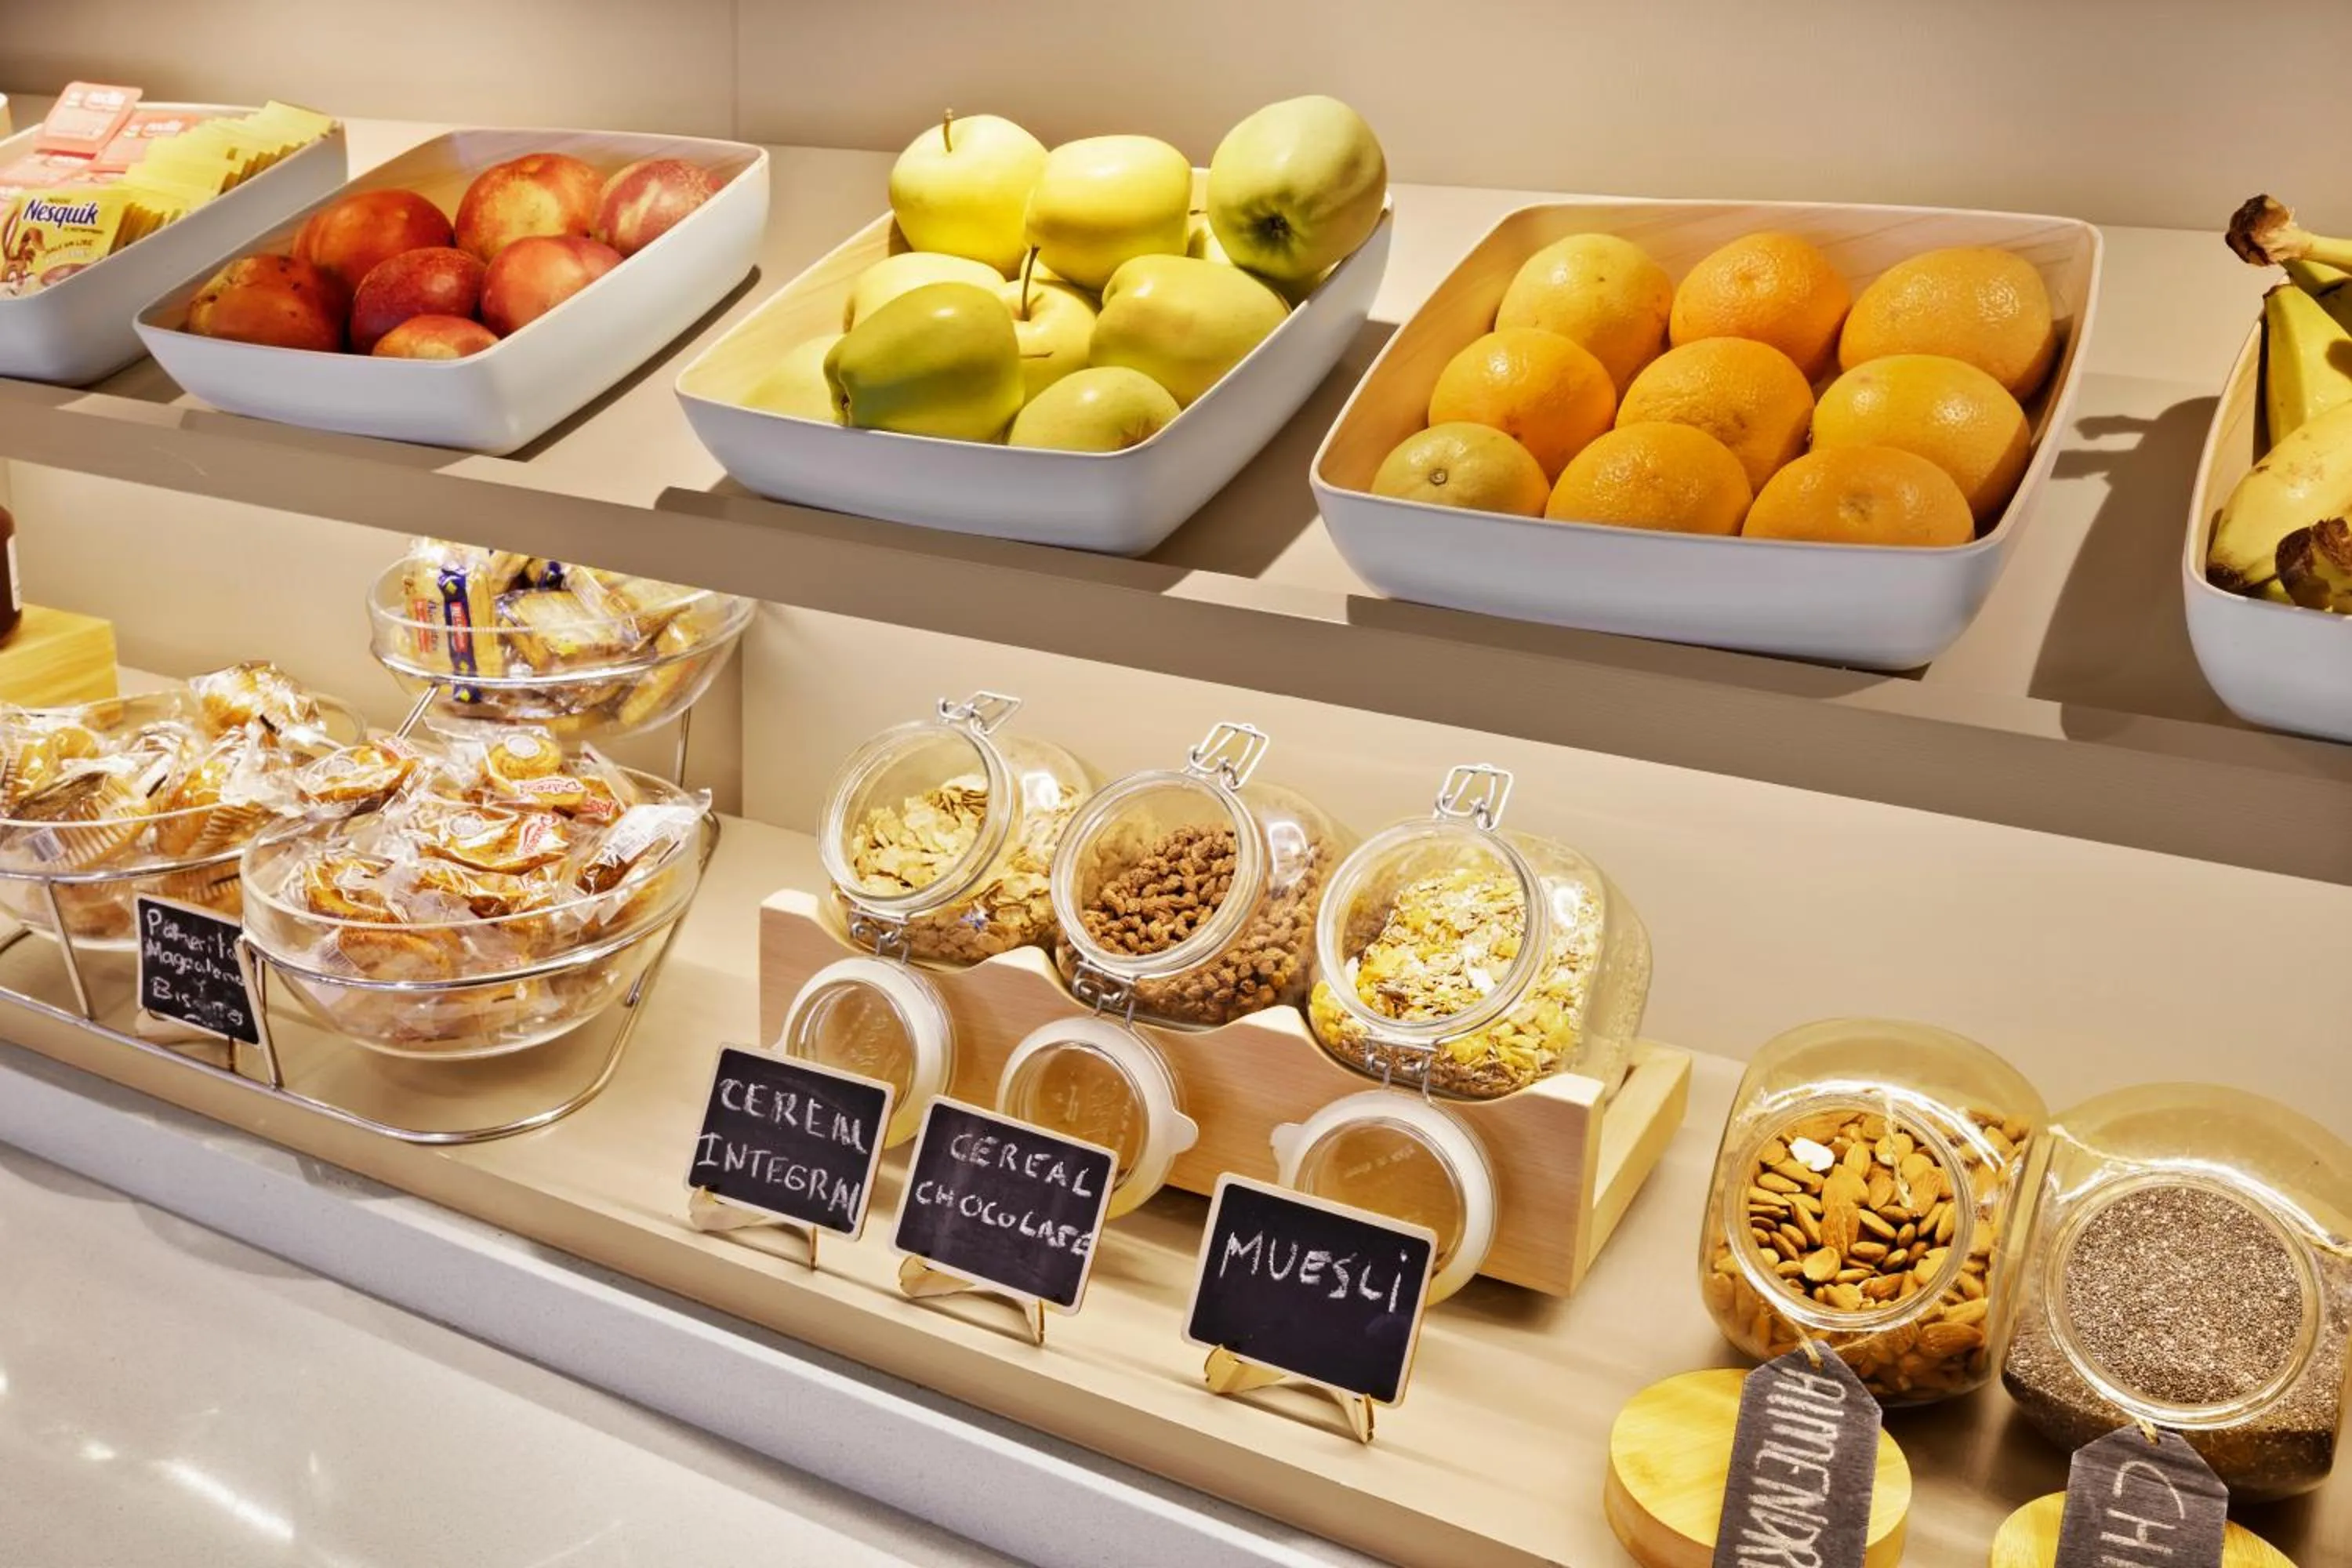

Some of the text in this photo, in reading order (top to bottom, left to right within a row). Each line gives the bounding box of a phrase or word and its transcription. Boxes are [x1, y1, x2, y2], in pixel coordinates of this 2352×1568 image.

[24, 199, 99, 229] Nesquik
[719, 1078, 868, 1154] CEREAL
[696, 1132, 861, 1224] INTEGRAL
[950, 1134, 1092, 1197] CEREAL
